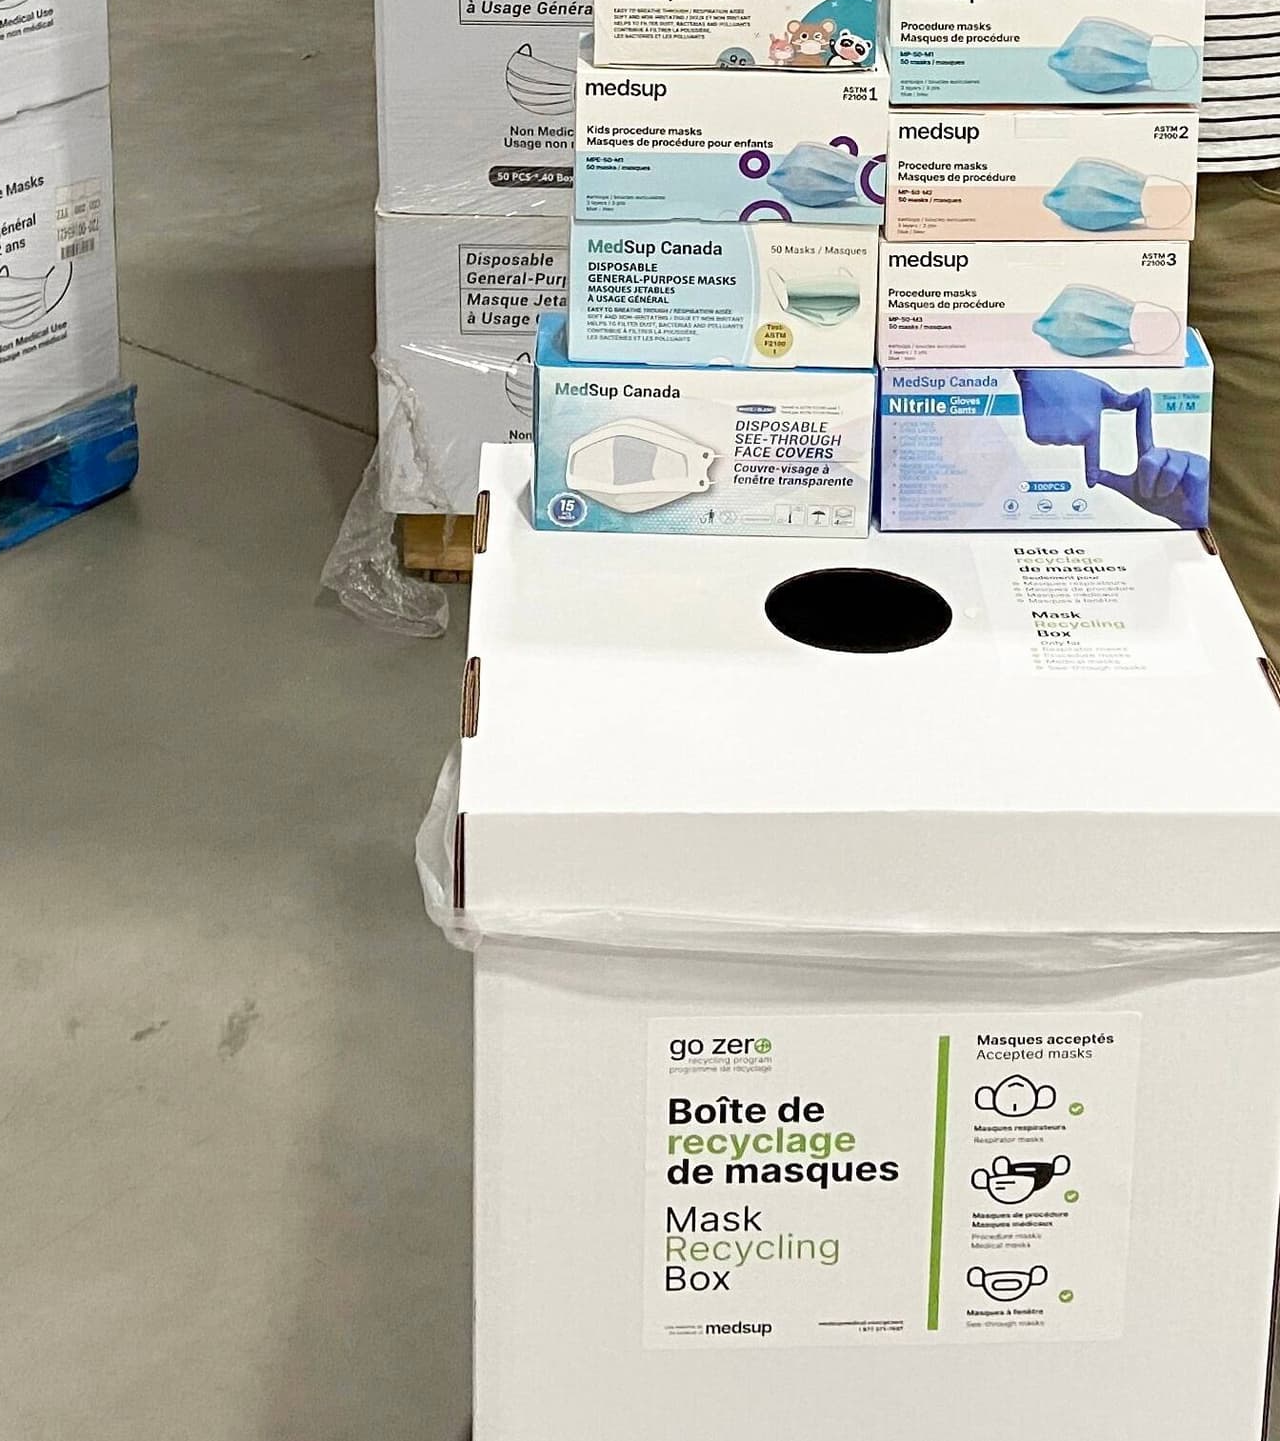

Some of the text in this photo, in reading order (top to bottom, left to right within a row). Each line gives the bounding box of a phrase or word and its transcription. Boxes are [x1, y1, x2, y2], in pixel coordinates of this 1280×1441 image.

[901, 22, 991, 31] Procedure masks
[900, 32, 1020, 44] Masques de procédure
[585, 80, 667, 101] medsup
[869, 87, 878, 101] 1
[586, 125, 702, 137] Kids procedure masks
[586, 138, 773, 149] Masques de procédure pour enfants
[588, 239, 722, 257] MedSup Canada
[785, 246, 815, 254] Masks
[825, 246, 867, 256] Masques
[588, 262, 658, 272] DISPOSABLE
[888, 251, 968, 272] medsup
[588, 274, 736, 286] GENERAL-PURPOSE MASKS
[588, 286, 675, 295] MASQUES JETABLES
[588, 294, 669, 304] À USAGE GÉNÉRAL
[892, 376, 998, 389] MedSup Canada
[555, 383, 680, 399] MedSup Canada
[889, 396, 981, 414] Nitrile Gloves
[950, 405, 976, 415] Gants
[735, 421, 828, 433] DISPOSABLE
[735, 434, 842, 446] SEE-THROUGH
[734, 447, 834, 459] FACE COVERS
[734, 463, 830, 476] Couvre-visage à
[733, 475, 854, 487] fenêtre transparente
[1032, 611, 1081, 619] Mask
[1035, 620, 1125, 629] Recycling
[977, 1033, 1114, 1047] Masques acceptés
[670, 1038, 704, 1061] go
[976, 1048, 1093, 1061] Accepted masks
[669, 1096, 825, 1124] Boîte de
[668, 1127, 856, 1160] recyclage
[667, 1159, 899, 1189] de masques
[666, 1205, 762, 1233] Mask
[666, 1233, 840, 1266] Recycling
[665, 1265, 730, 1291] Box
[705, 1321, 772, 1337] medsup
